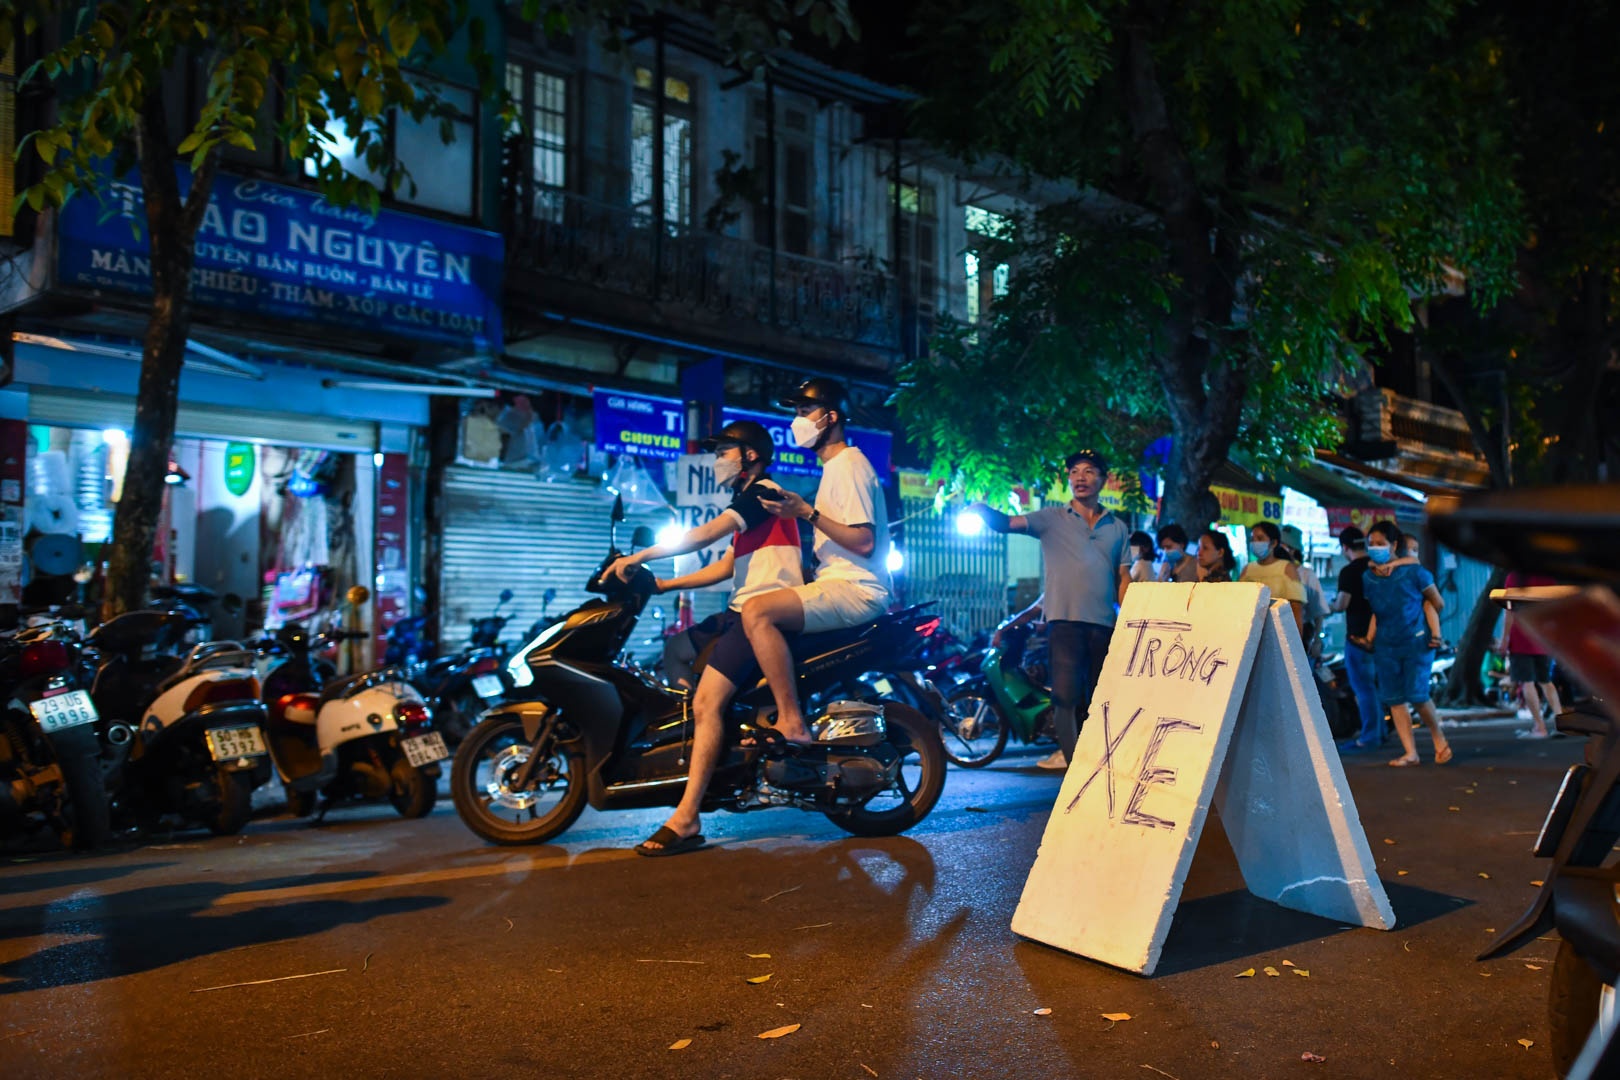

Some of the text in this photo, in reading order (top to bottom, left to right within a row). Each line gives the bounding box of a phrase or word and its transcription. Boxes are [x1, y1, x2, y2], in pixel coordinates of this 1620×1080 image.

[257, 251, 298, 274] BÁN
[303, 261, 357, 285] BUÔN
[370, 272, 409, 295] BÁN
[287, 219, 471, 285] NGUYÊN
[619, 429, 681, 449] CHUYÊN
[1263, 500, 1281, 520] 88
[1123, 618, 1229, 686] TRÔNG
[1064, 701, 1205, 834] XE
